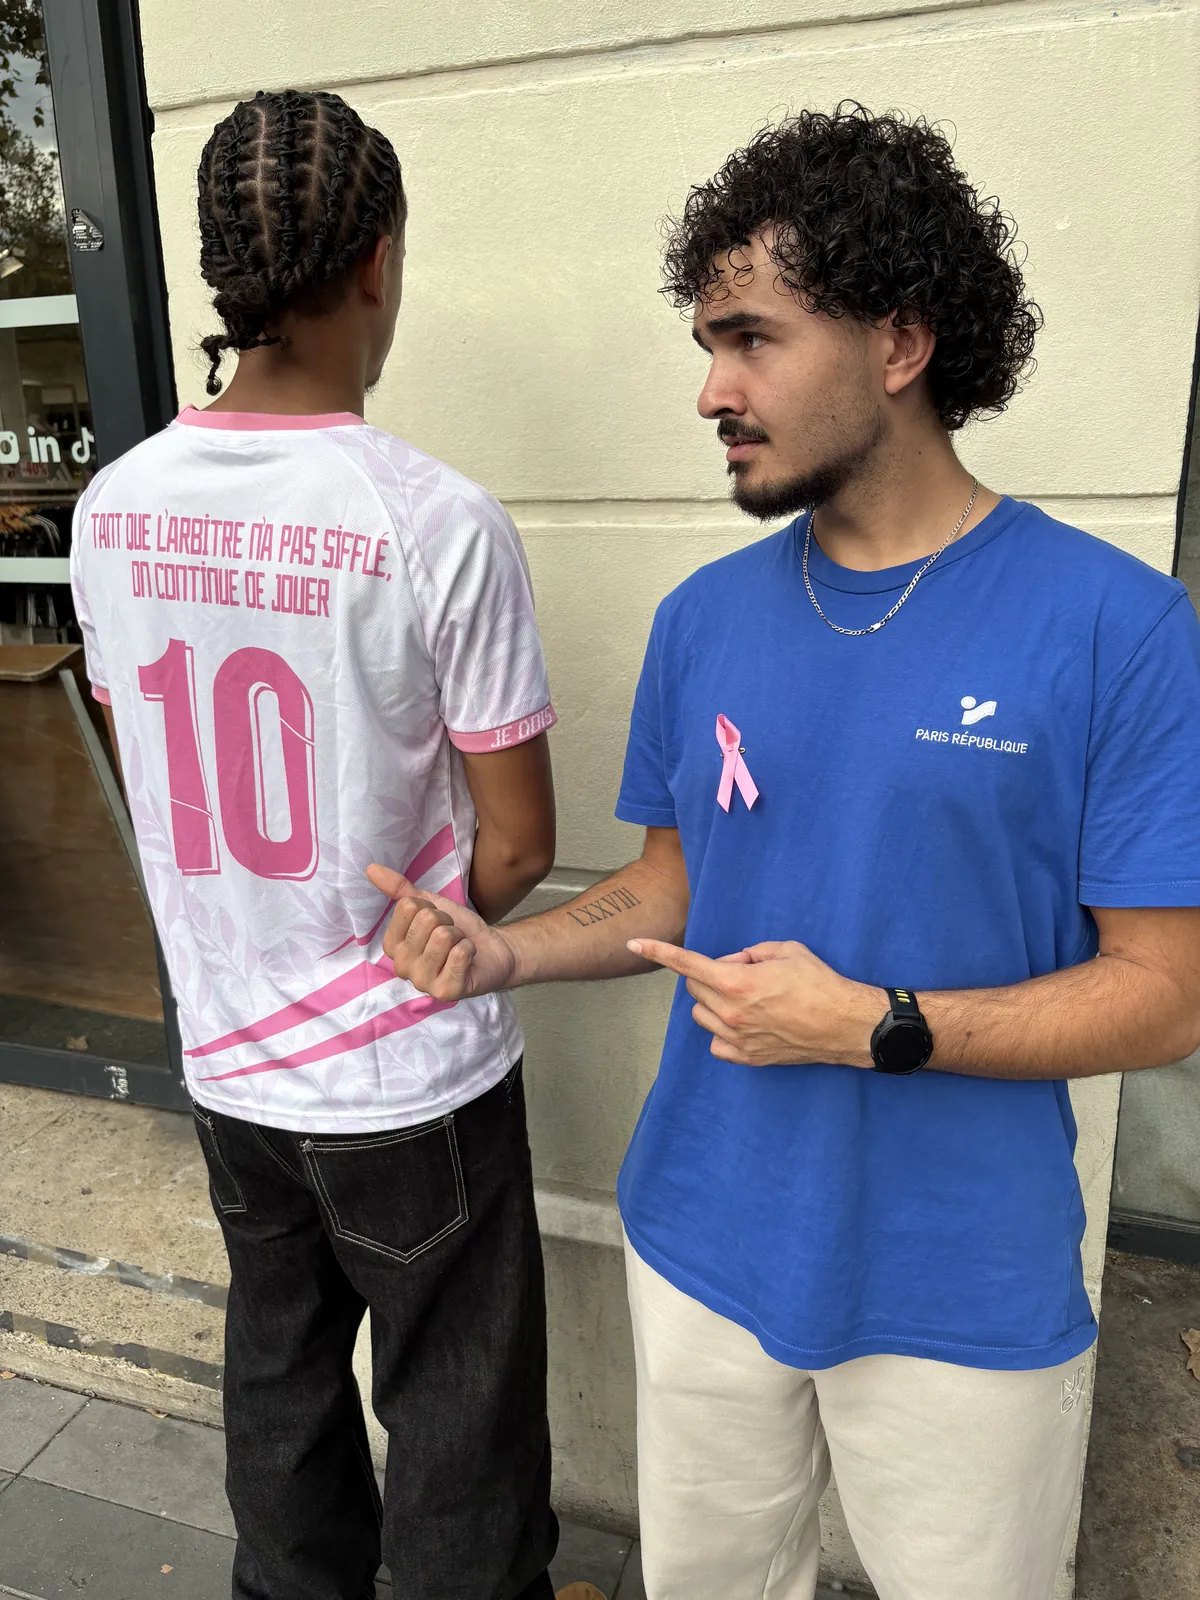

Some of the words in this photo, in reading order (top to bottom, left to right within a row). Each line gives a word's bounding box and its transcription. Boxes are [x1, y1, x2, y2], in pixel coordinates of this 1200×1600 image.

[91, 513, 122, 549] TANT
[126, 512, 152, 551] QUE
[157, 508, 245, 559] L'ARBITRE
[249, 516, 274, 562] N'A
[278, 524, 316, 566] PAS
[322, 524, 392, 582] SIFFLÉ,
[132, 560, 152, 598] ON
[154, 560, 240, 607] CONTINUE
[244, 571, 266, 610] DE
[272, 574, 330, 618] JOUER
[138, 638, 320, 882] 10
[490, 726, 513, 748] JE
[915, 728, 950, 743] PARIS
[951, 731, 1029, 754] RÉPUBLIQUE
[566, 887, 642, 927] LXXVIII
